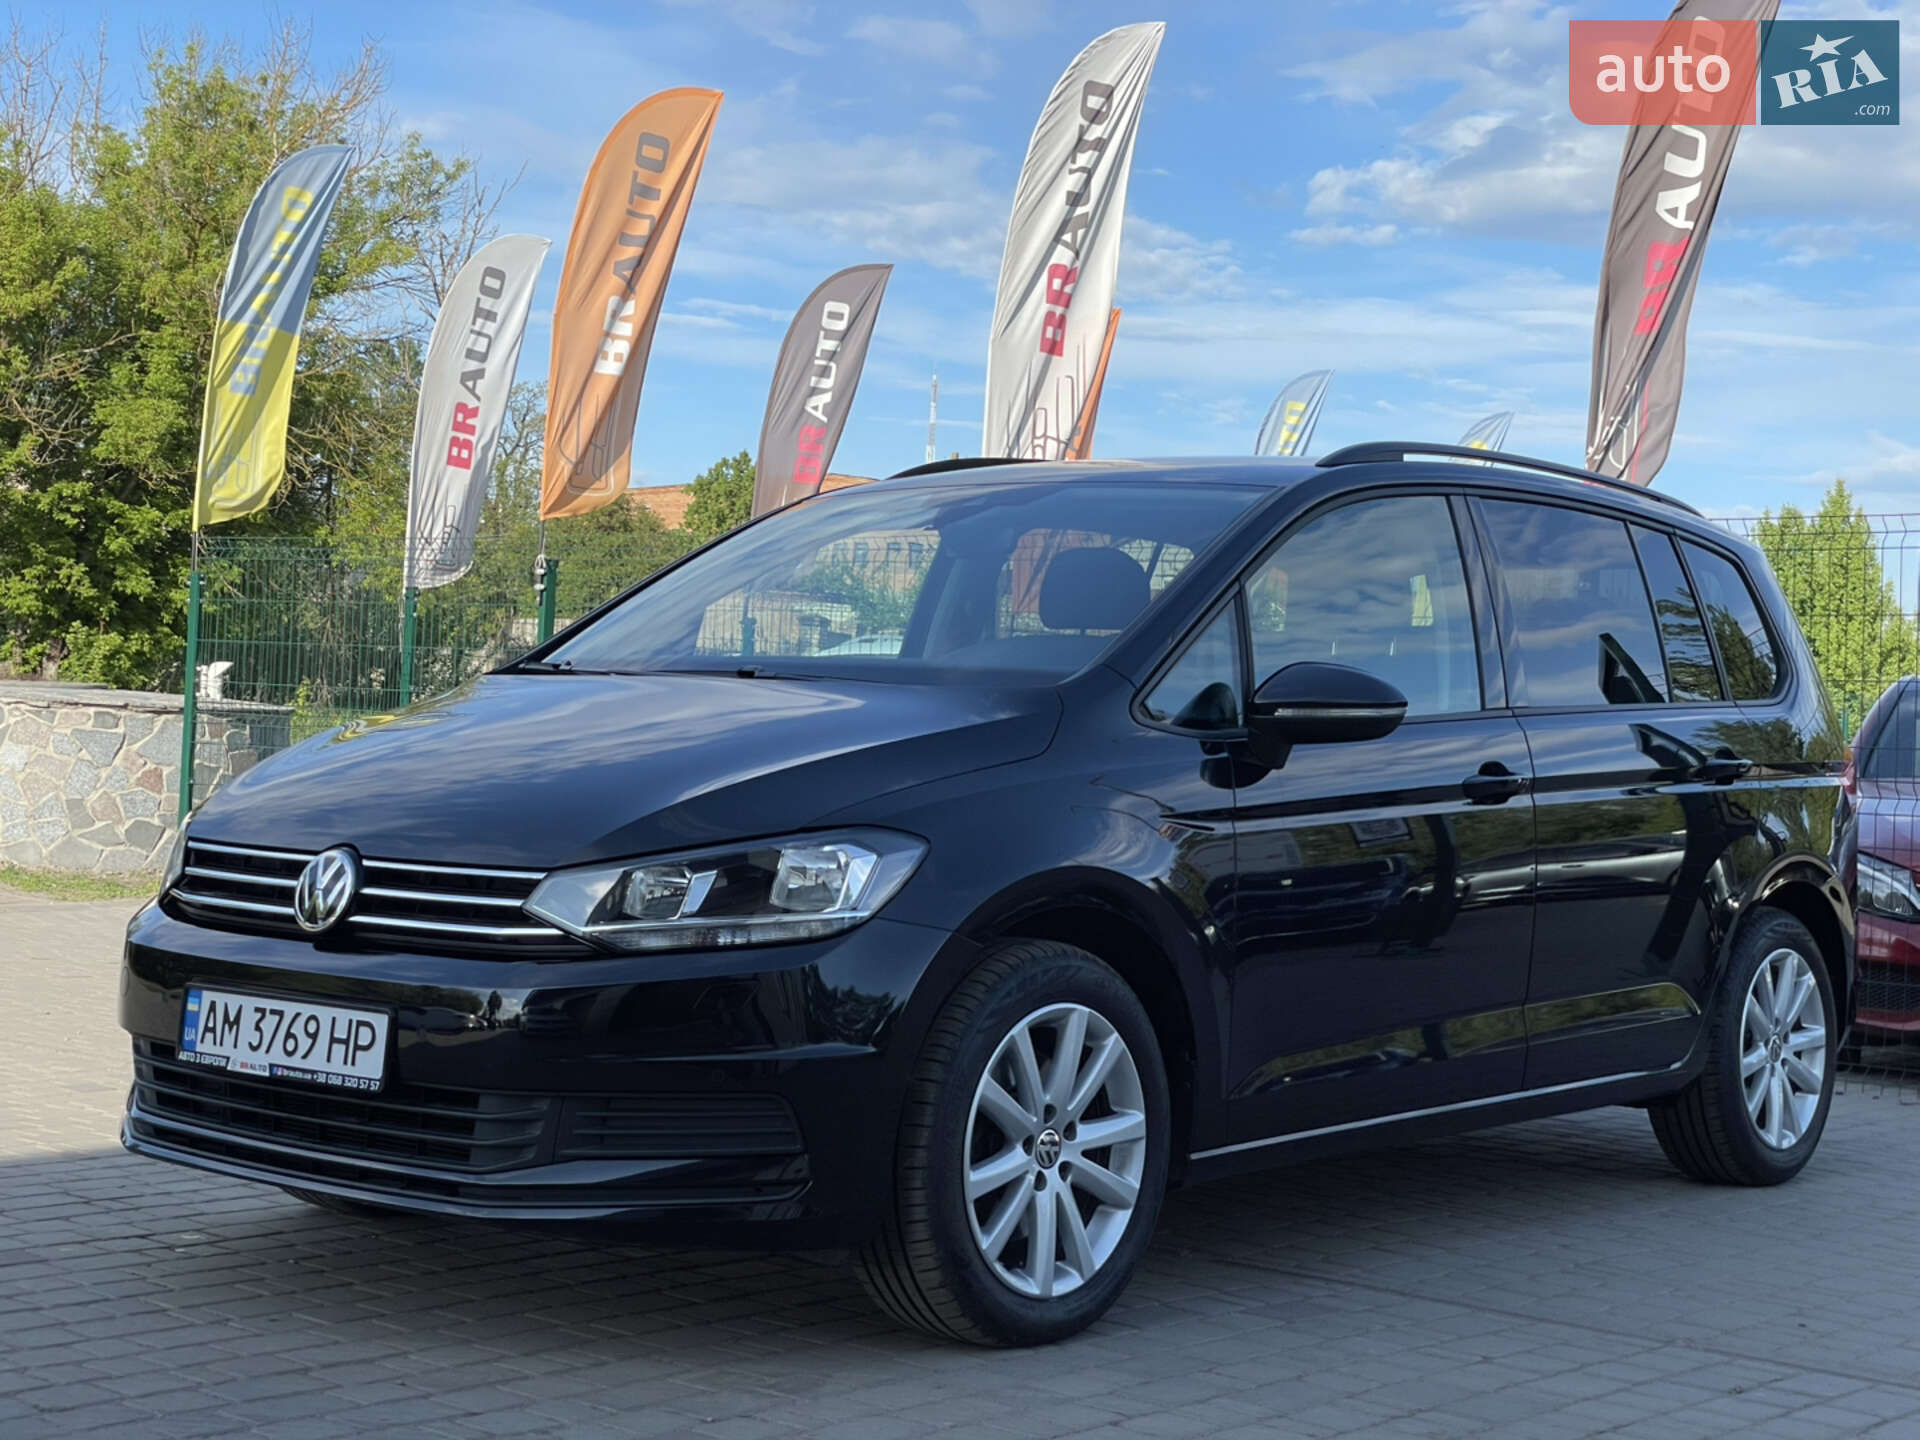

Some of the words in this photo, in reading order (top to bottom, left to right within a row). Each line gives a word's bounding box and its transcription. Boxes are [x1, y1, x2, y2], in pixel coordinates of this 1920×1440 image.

[594, 131, 671, 377] BRAUTO
[1040, 79, 1115, 357] BRAUTO
[446, 265, 507, 471] BRAUTO
[793, 300, 851, 485] BRAUTO
[184, 1027, 196, 1042] UA
[200, 1000, 243, 1049] AM
[248, 1006, 320, 1060] 3769
[326, 1016, 377, 1067] HP
[359, 1079, 369, 1089] 57
[370, 1080, 380, 1091] 57
